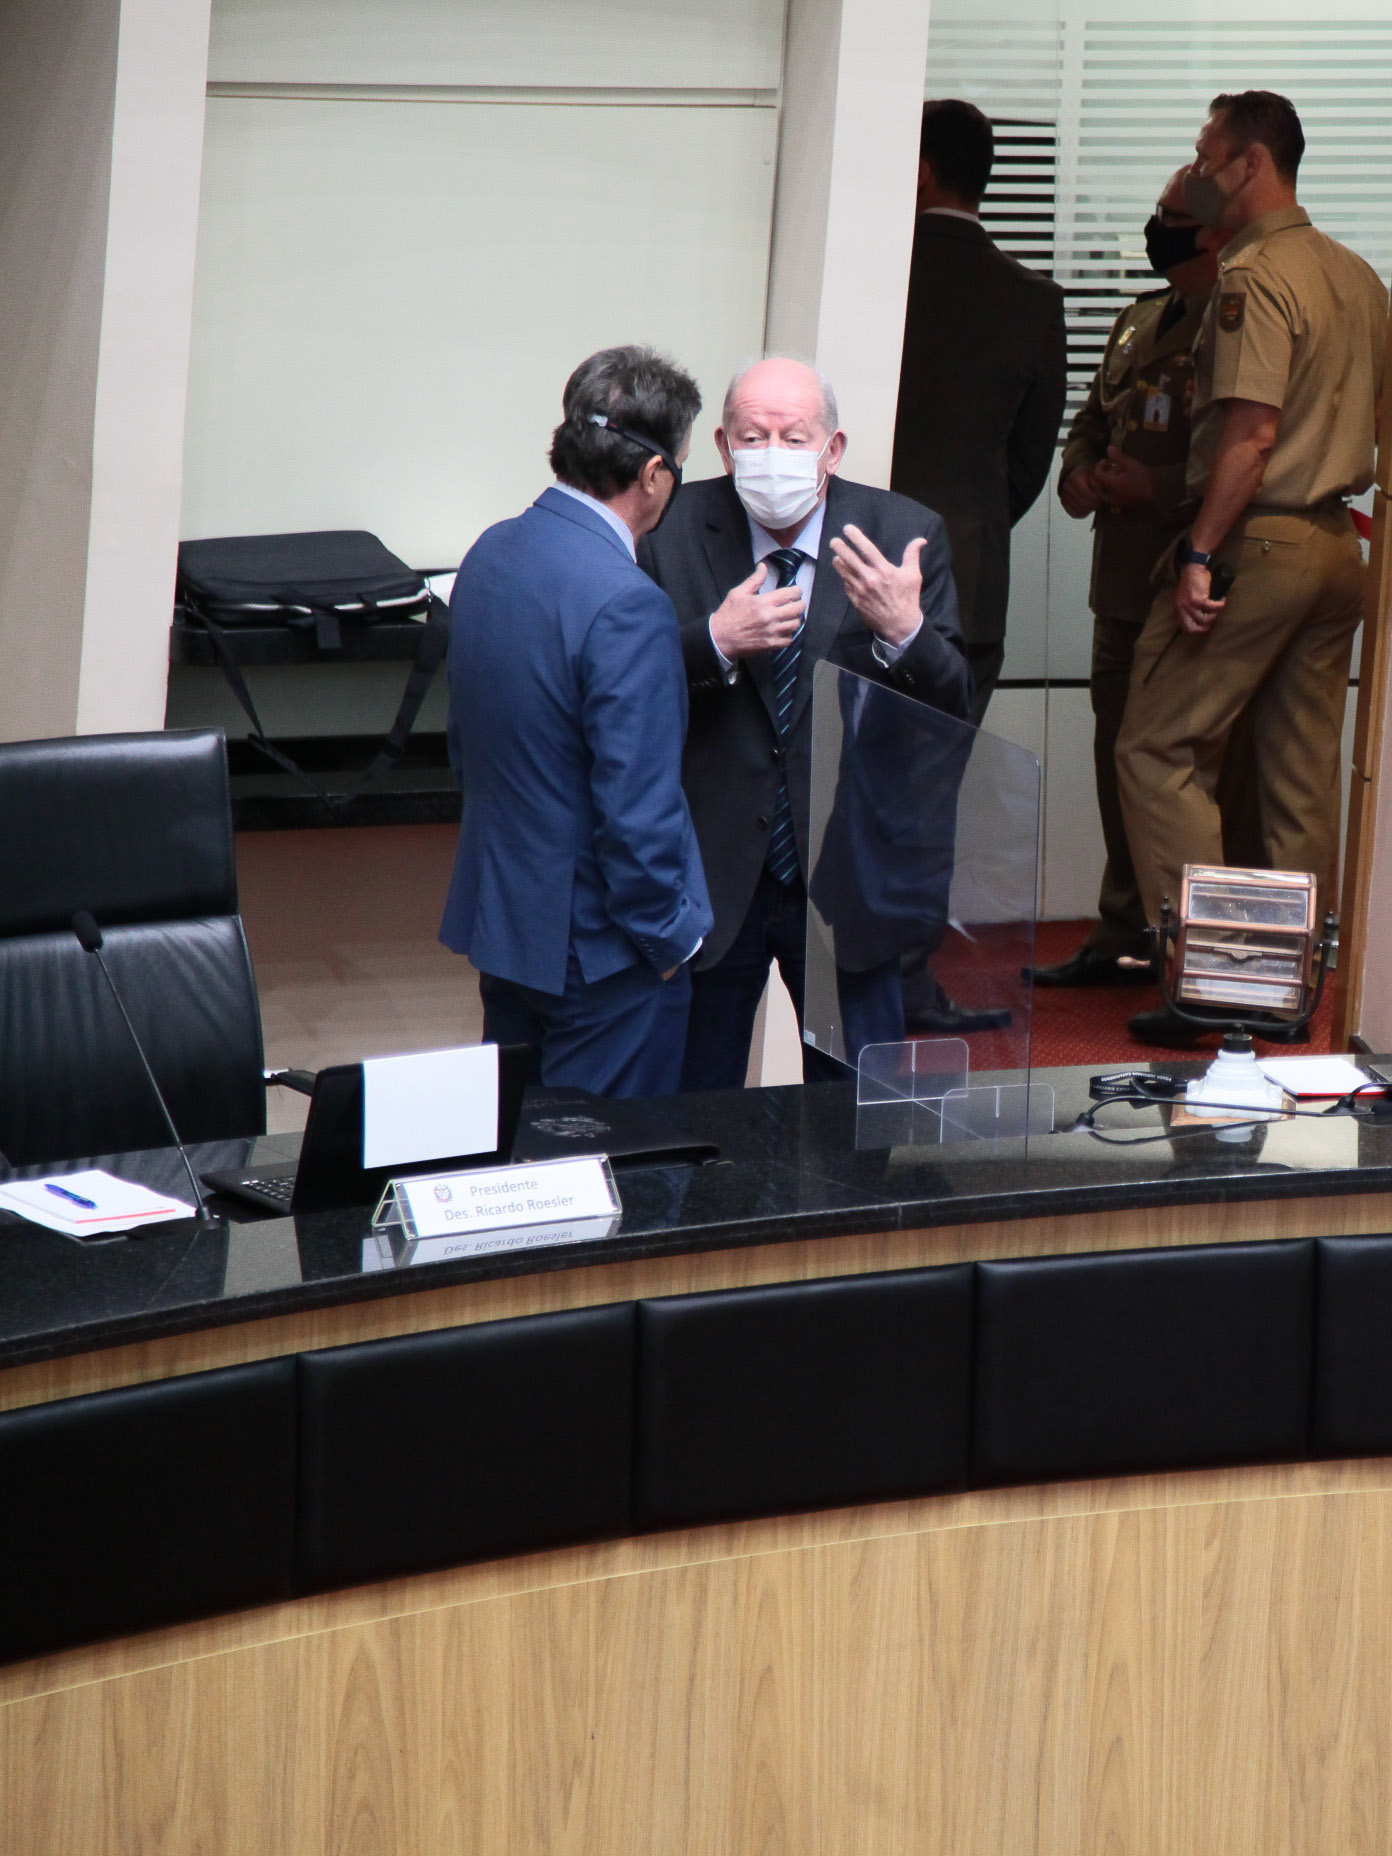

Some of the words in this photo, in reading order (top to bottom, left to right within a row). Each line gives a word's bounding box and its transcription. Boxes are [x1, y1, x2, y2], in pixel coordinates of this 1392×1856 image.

[469, 1180, 538, 1197] Presidente
[444, 1208, 473, 1221] Des.
[475, 1202, 524, 1217] Ricardo
[527, 1195, 574, 1211] Roesler
